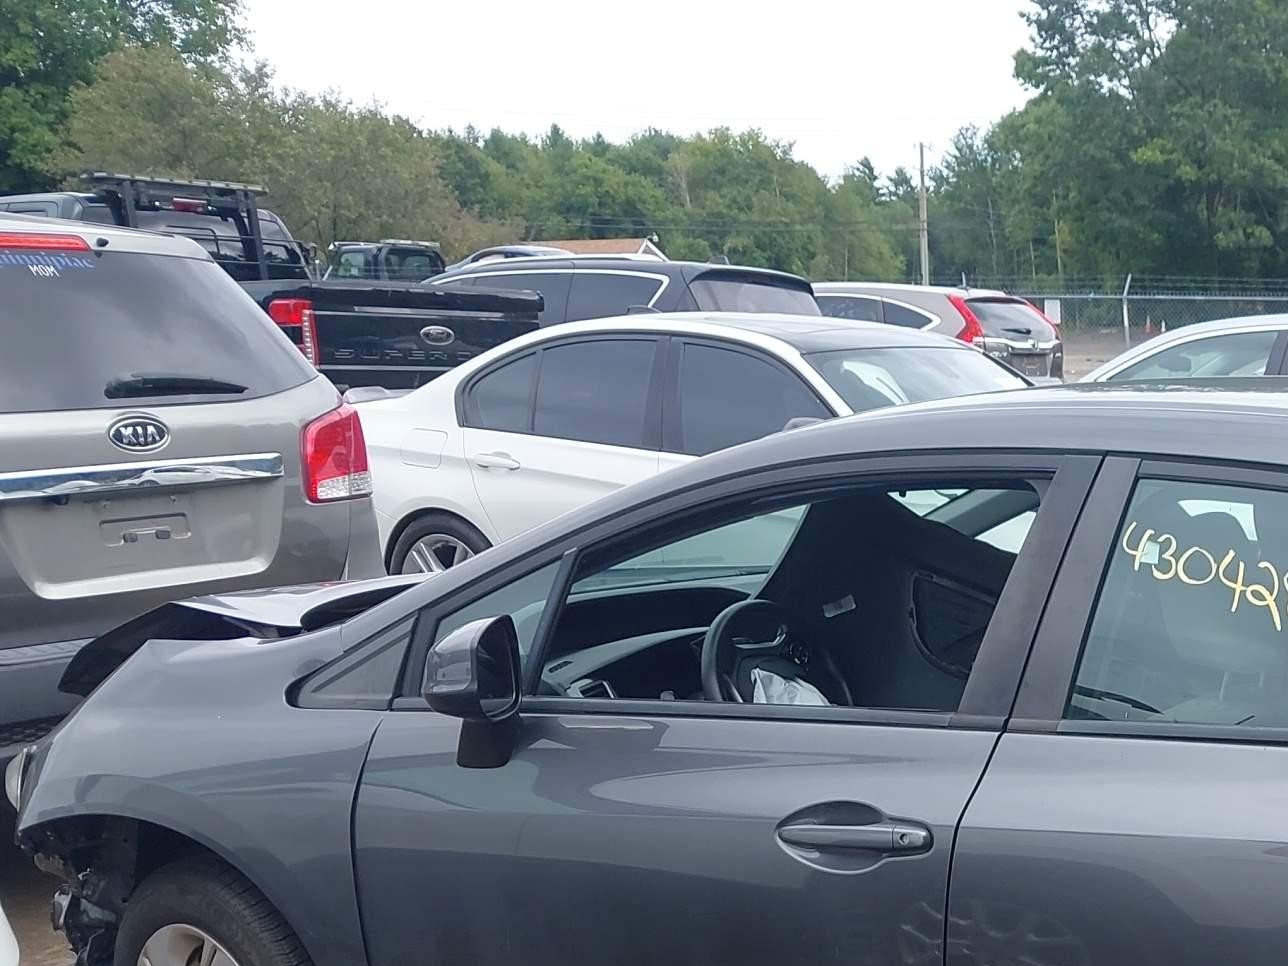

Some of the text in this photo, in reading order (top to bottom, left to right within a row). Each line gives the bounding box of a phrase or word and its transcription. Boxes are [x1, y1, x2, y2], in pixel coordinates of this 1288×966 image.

[28, 264, 60, 277] MOM
[334, 349, 448, 361] SUPER
[119, 425, 160, 444] KIA
